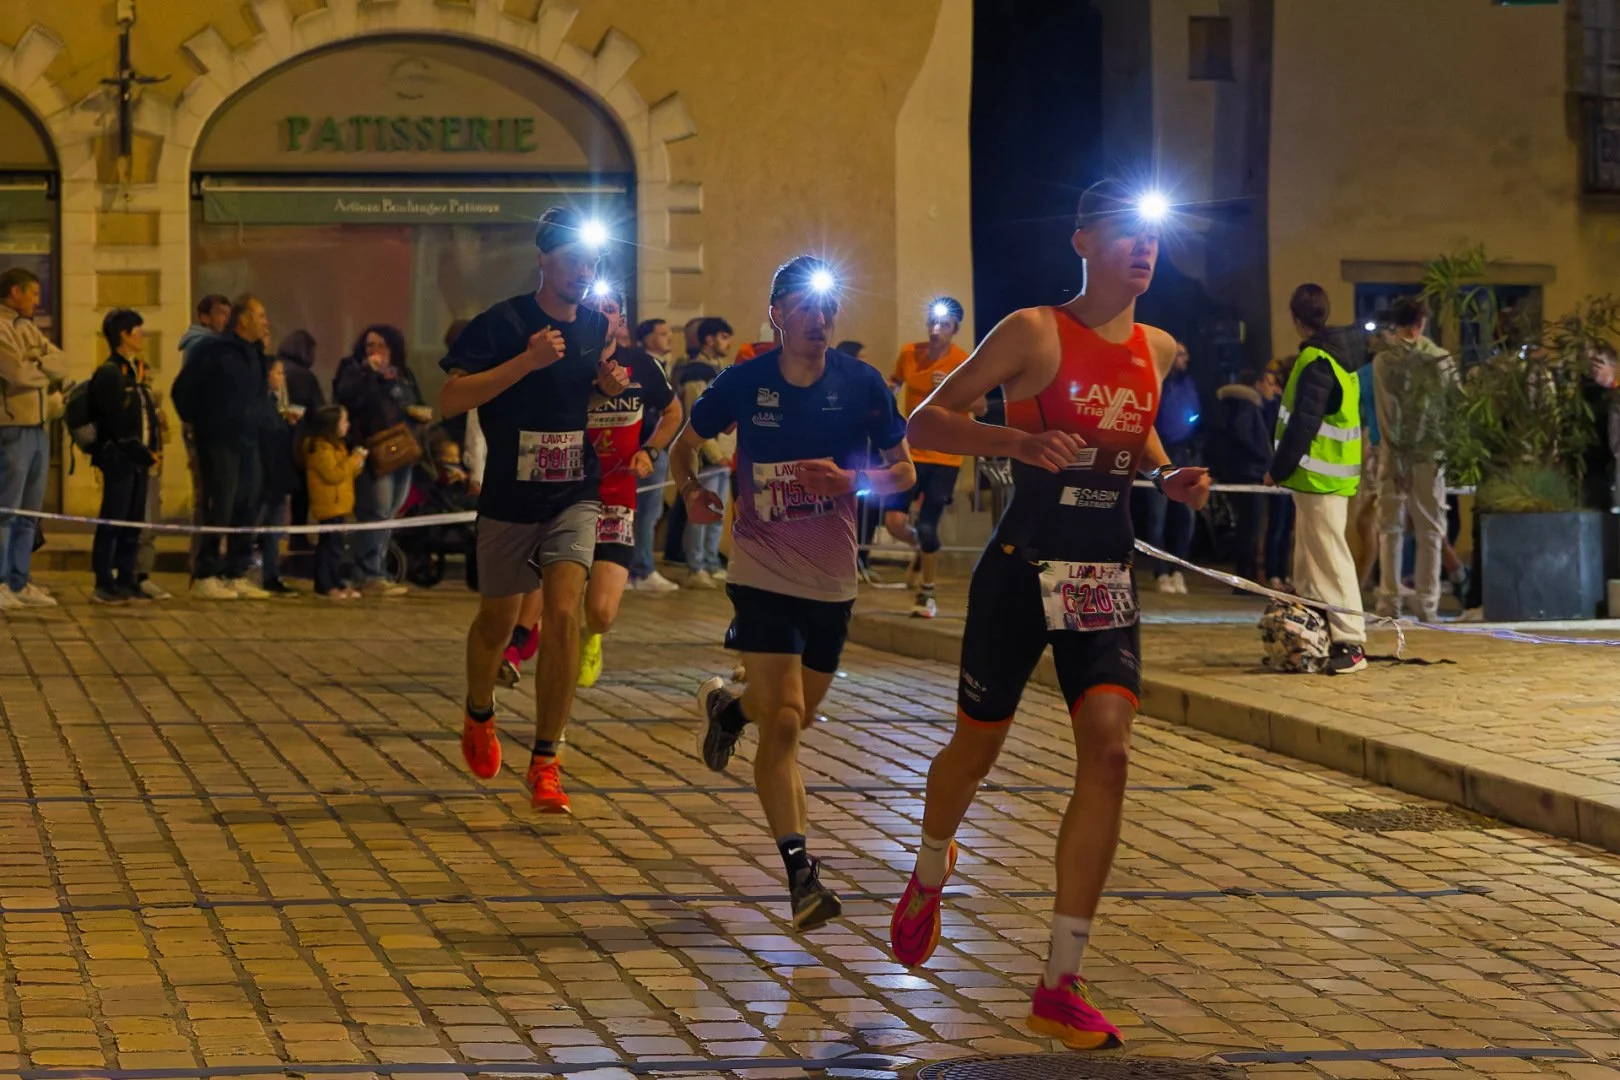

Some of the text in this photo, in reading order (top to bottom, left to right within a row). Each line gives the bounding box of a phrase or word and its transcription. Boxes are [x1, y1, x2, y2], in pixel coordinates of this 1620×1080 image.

[284, 115, 538, 152] PATISSERIE
[1113, 420, 1144, 434] Club
[538, 447, 568, 469] 691
[1061, 583, 1114, 613] 620
